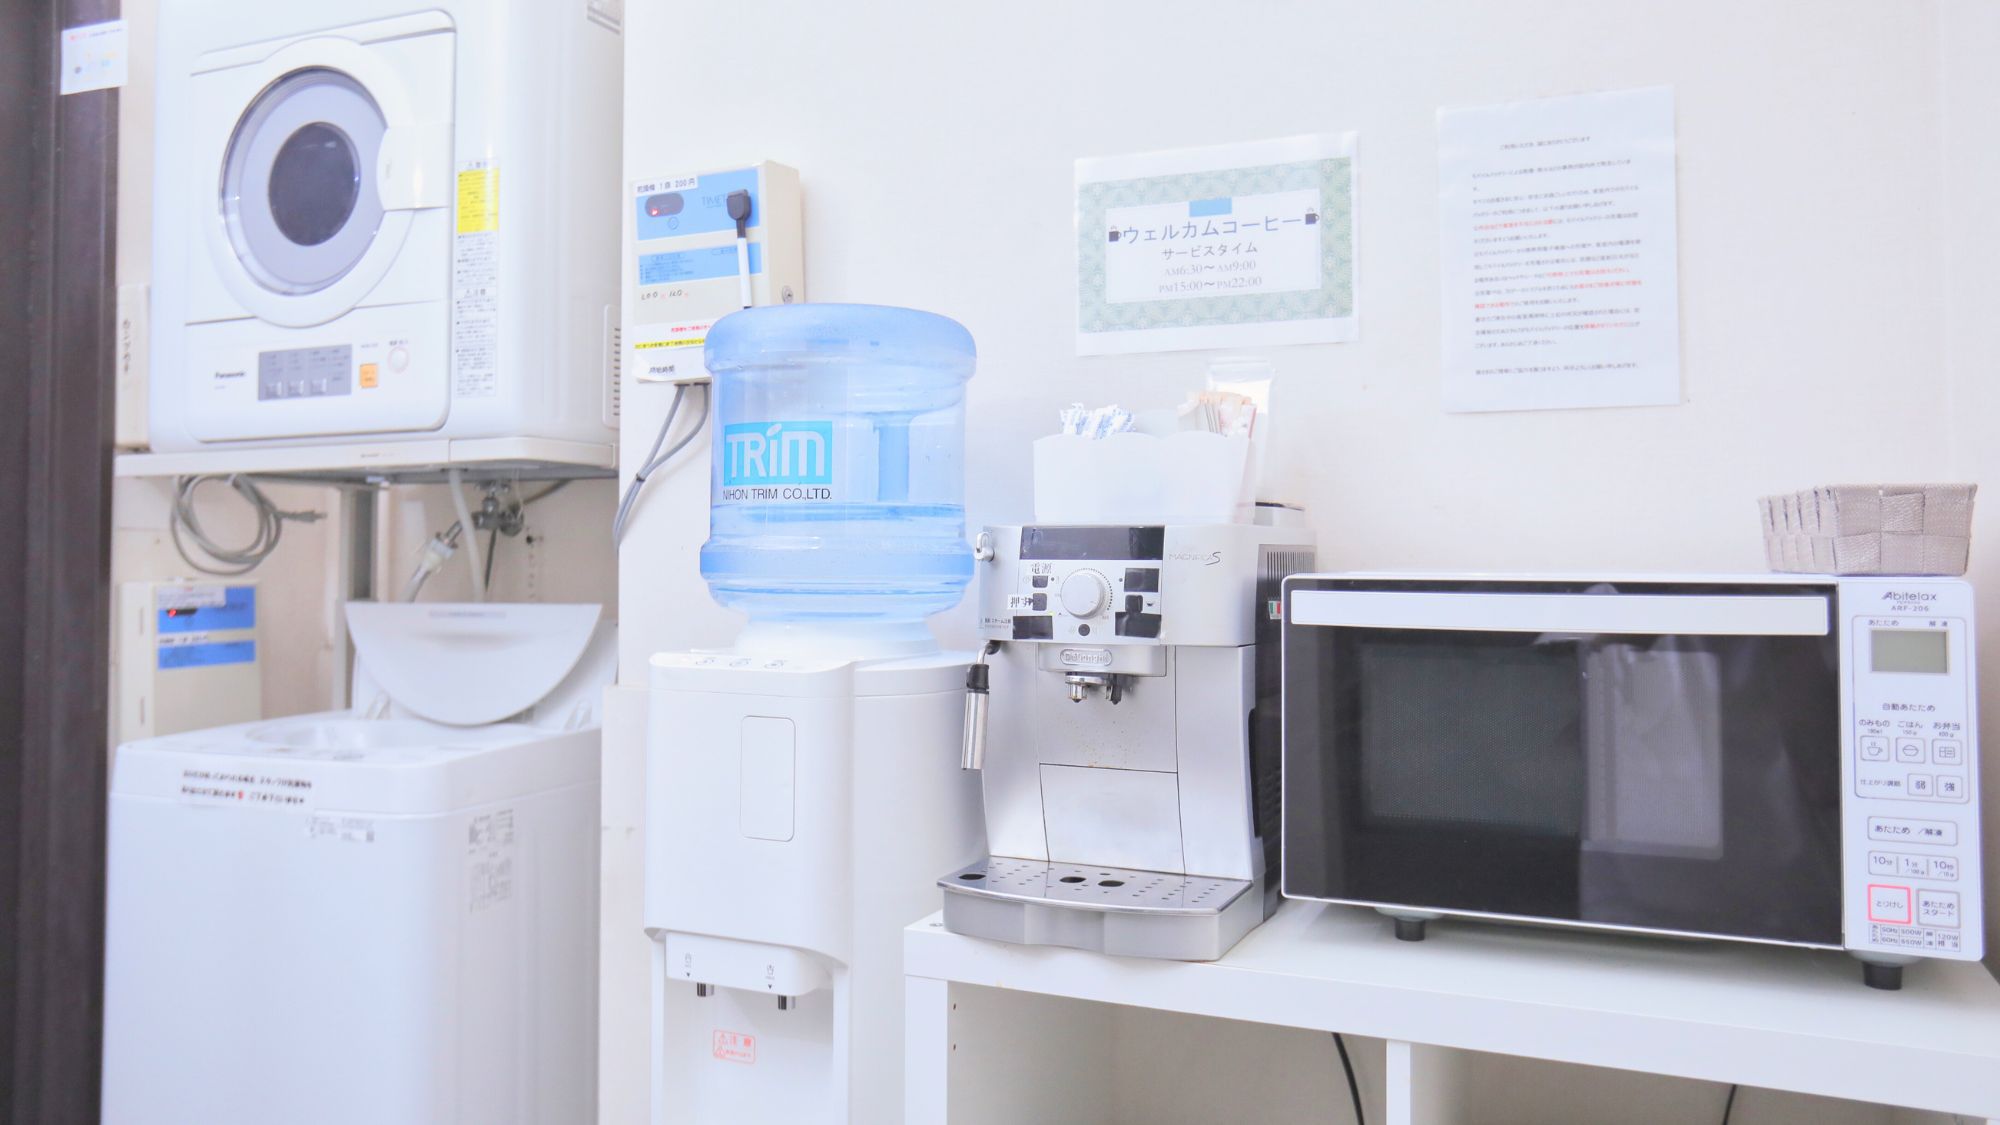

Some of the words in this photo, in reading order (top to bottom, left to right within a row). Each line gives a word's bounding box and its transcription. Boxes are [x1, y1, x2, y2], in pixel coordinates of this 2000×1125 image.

[1122, 215, 1301, 244] ウェルカムコーヒー
[1161, 242, 1258, 260] サービスタイム
[722, 489, 748, 500] NIHON
[751, 488, 778, 500] TRIM
[1882, 591, 1937, 601] Abitelax
[1882, 702, 1936, 712] 自動あたため
[1859, 718, 1890, 728] のみもの
[1897, 720, 1923, 729] ごはん
[1932, 722, 1961, 731] お弁当
